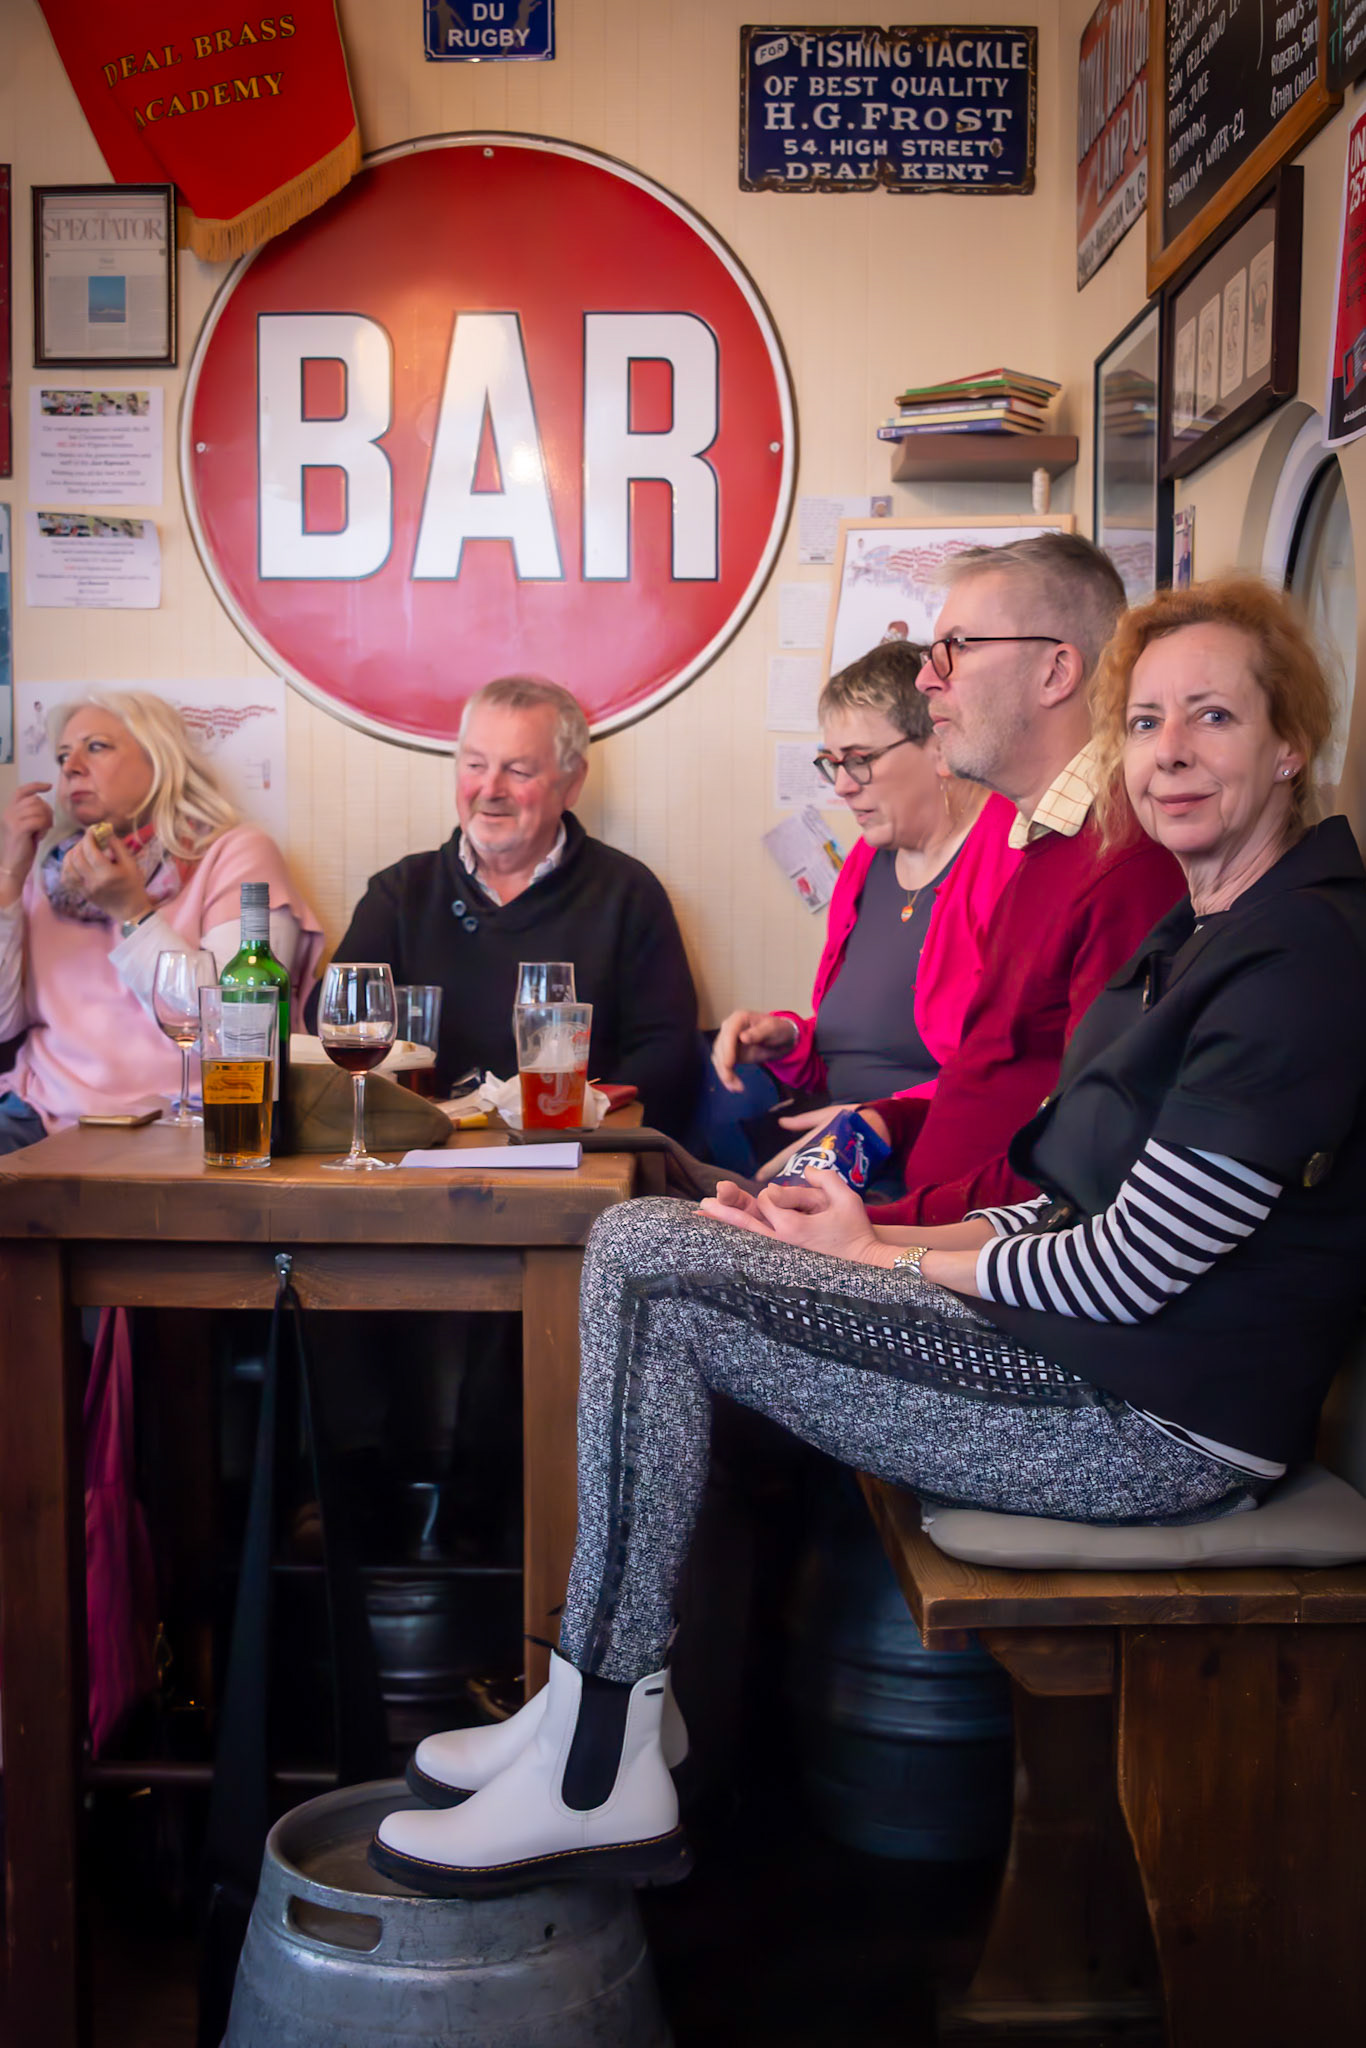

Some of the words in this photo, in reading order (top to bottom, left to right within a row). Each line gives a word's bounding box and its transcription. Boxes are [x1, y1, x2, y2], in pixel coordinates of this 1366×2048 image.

[472, 2, 504, 21] DU
[447, 28, 530, 47] RUGBY
[102, 45, 182, 88] DEAL
[192, 15, 296, 60] BRASS
[758, 41, 786, 61] FOR
[801, 36, 912, 68] FISHING
[924, 40, 1028, 69] TACKLE
[763, 75, 799, 97] OF
[808, 76, 878, 97] BEST
[890, 77, 1009, 98] QUALITY
[1188, 70, 1210, 112] JUICE
[134, 72, 284, 131] ACADEMY
[829, 139, 888, 156] HIGH
[901, 140, 989, 157] STREET
[786, 162, 874, 180] DEAL
[901, 163, 989, 181] KENT
[43, 216, 164, 242] SPECTATOR
[257, 311, 719, 581] BAR
